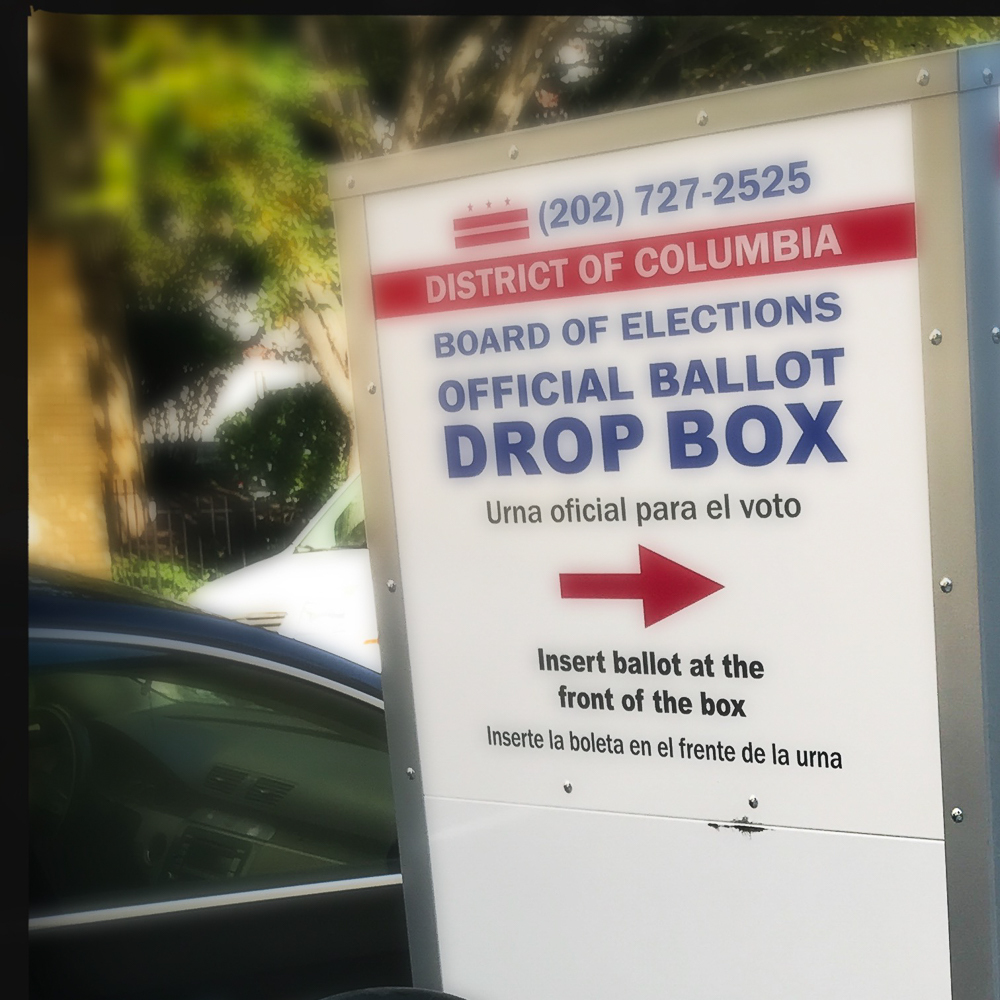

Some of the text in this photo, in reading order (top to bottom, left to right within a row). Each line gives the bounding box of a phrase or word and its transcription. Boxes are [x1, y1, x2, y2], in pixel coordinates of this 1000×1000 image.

[539, 160, 811, 236] (202) 727-2525
[426, 224, 842, 303] DISTRICT OF COLUMBIA
[434, 292, 842, 358] BOARD OF ELECTIONS
[438, 347, 844, 412] OFFICIAL BALLOT
[444, 400, 848, 479] DROP BOX
[486, 493, 801, 527] Urna oficial para el voto
[537, 648, 764, 679] Insert ballot at the
[558, 685, 747, 717] front of the box
[487, 725, 842, 769] Inserte la boleta en el frente de la urna
